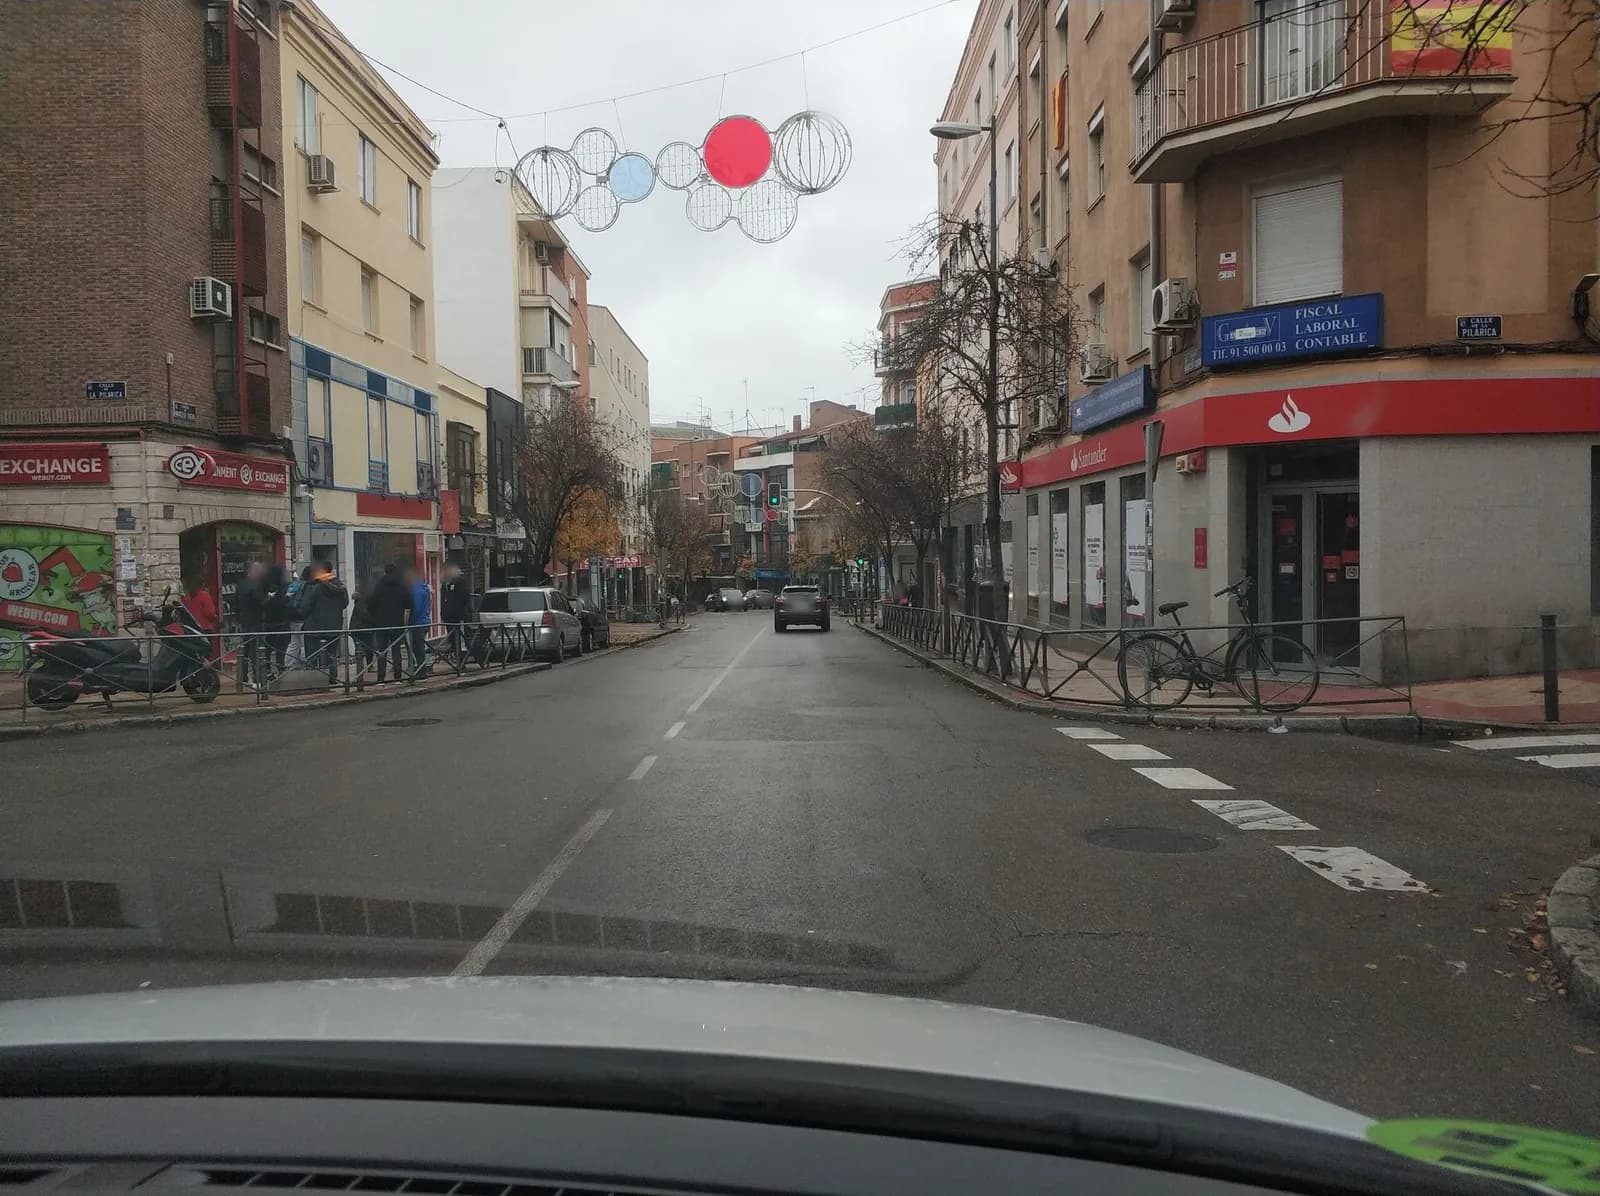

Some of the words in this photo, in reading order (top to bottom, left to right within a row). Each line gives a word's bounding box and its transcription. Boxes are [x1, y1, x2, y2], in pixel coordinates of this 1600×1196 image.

[1295, 303, 1343, 320] FISCAL
[1295, 317, 1360, 335] LABORAL
[1462, 328, 1497, 337] PILARICA
[1230, 348, 1240, 357] 91
[1243, 346, 1259, 356] 500
[1262, 344, 1273, 353] 00
[1275, 341, 1286, 352] 03
[1295, 332, 1368, 351] CONTABLE
[1078, 441, 1107, 469] Santander
[0, 458, 102, 474] EXCHANGE
[255, 470, 285, 484] EXCHANGE
[7, 604, 69, 627] WEBUY.COM
